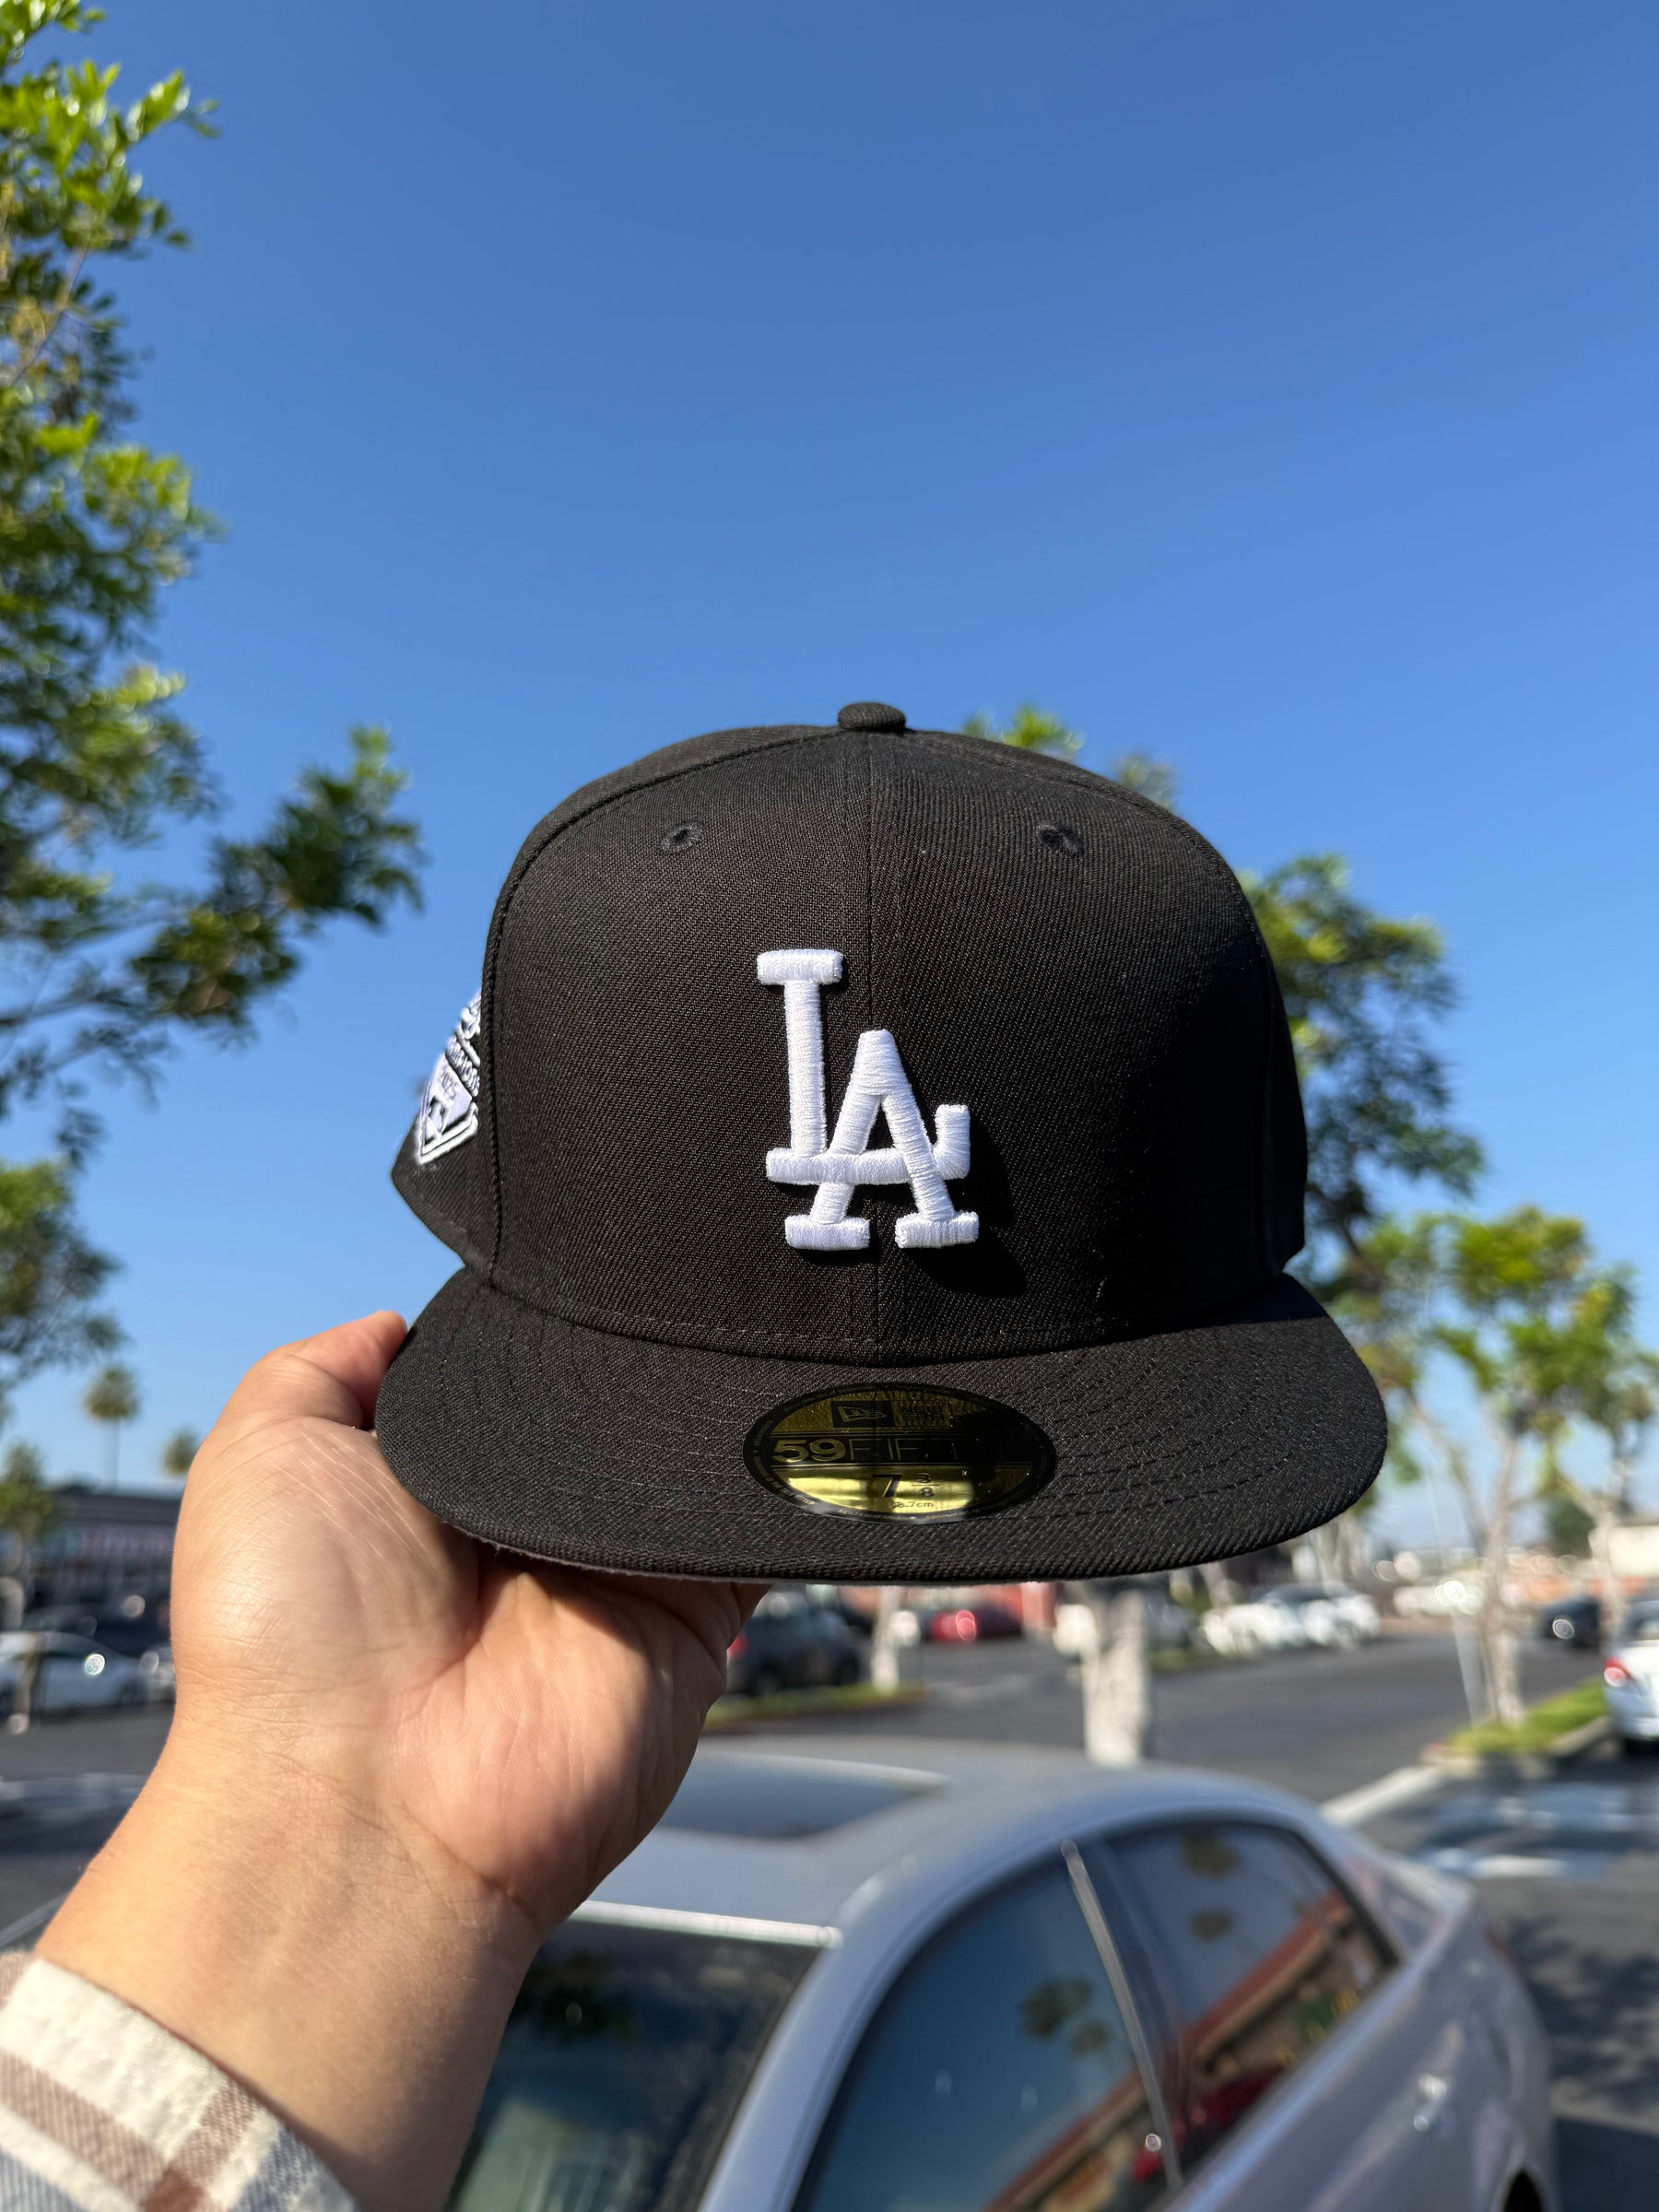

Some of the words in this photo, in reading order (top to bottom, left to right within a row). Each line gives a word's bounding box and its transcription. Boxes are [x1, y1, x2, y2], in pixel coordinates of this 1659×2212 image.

[758, 948, 980, 1250] LA
[772, 1438, 1010, 1463] 59FIFT
[872, 1473, 902, 1498] 7
